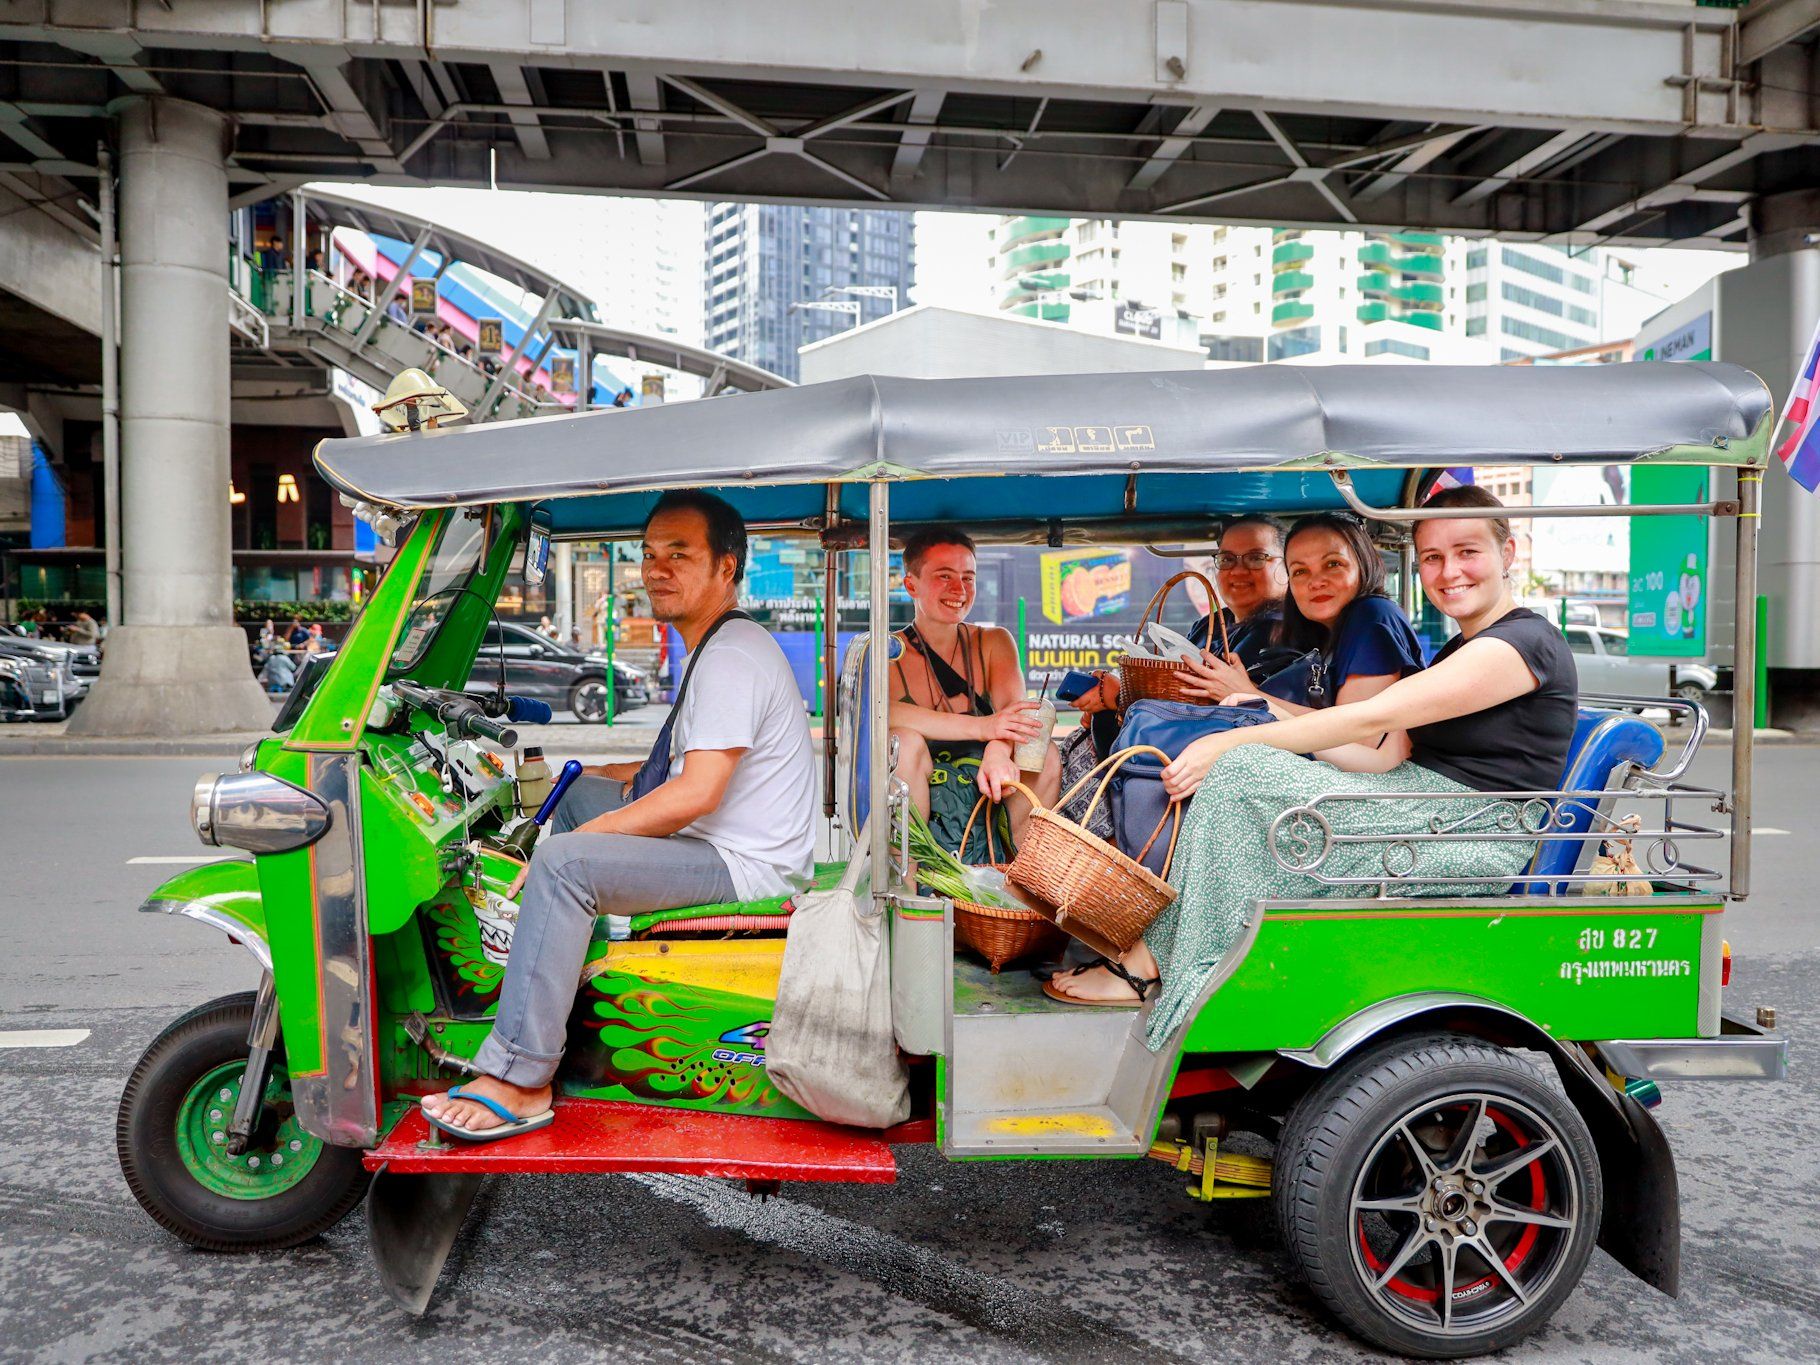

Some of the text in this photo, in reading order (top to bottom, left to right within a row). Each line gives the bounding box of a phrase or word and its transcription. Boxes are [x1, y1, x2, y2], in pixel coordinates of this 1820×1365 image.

[1028, 634, 1100, 649] NATURAL
[1613, 928, 1658, 949] 827
[1560, 960, 1691, 985] กรุงเทพมหานคร
